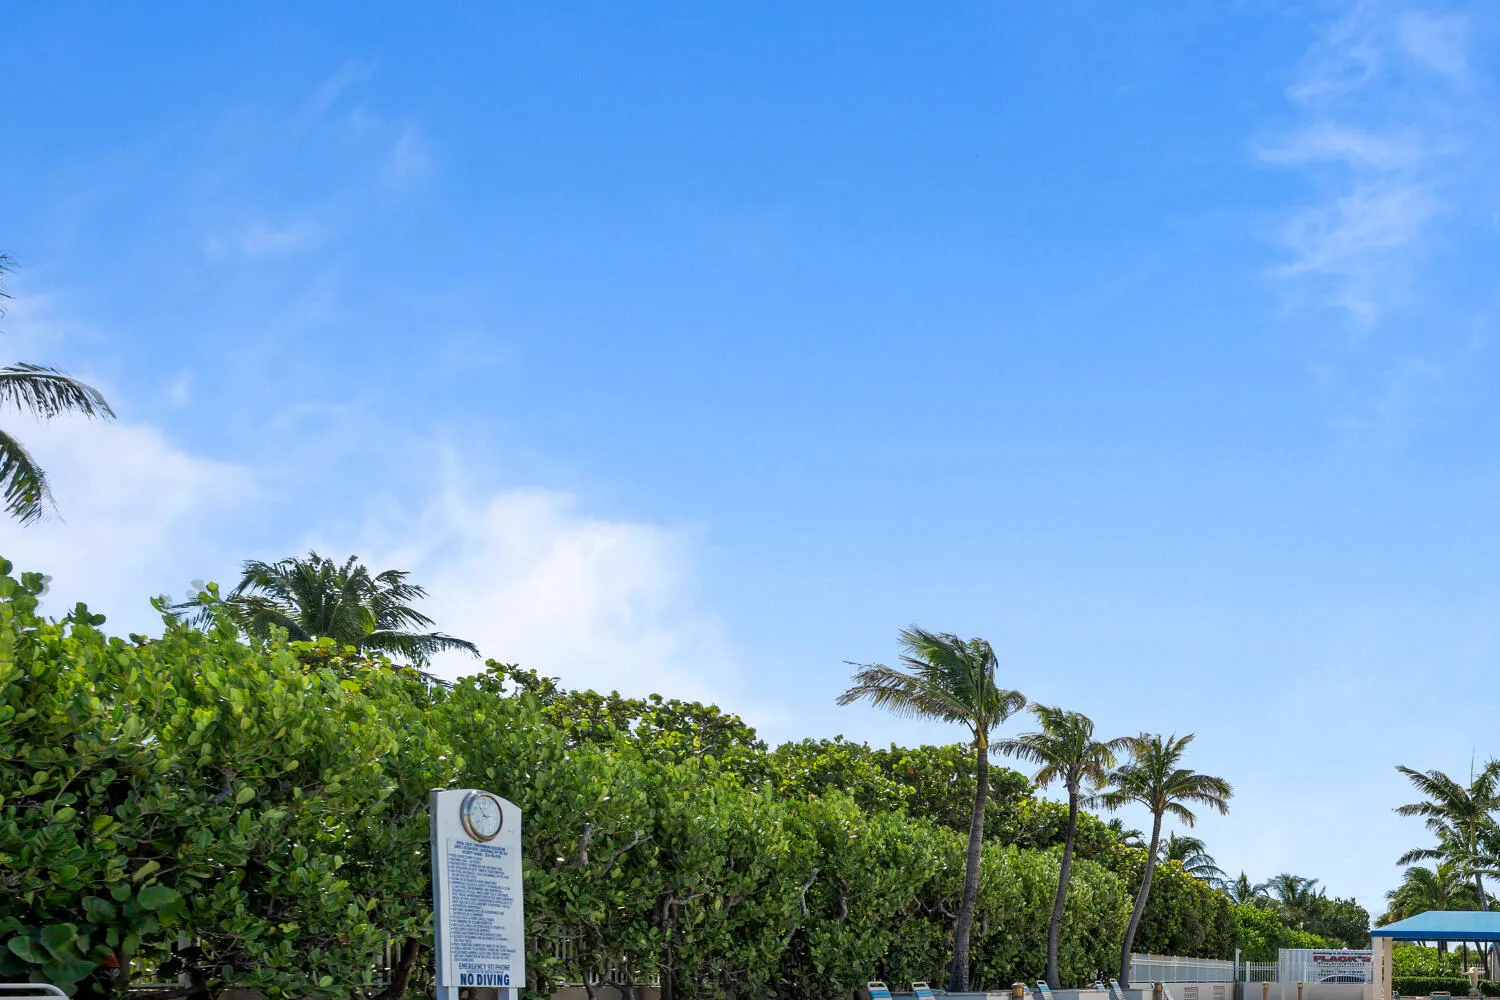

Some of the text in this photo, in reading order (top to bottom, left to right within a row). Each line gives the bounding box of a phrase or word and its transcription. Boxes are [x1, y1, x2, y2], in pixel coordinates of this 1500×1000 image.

[458, 962, 487, 970] EMERGENCY
[495, 963, 511, 971] PHONE
[460, 973, 510, 986] NO DIVING
